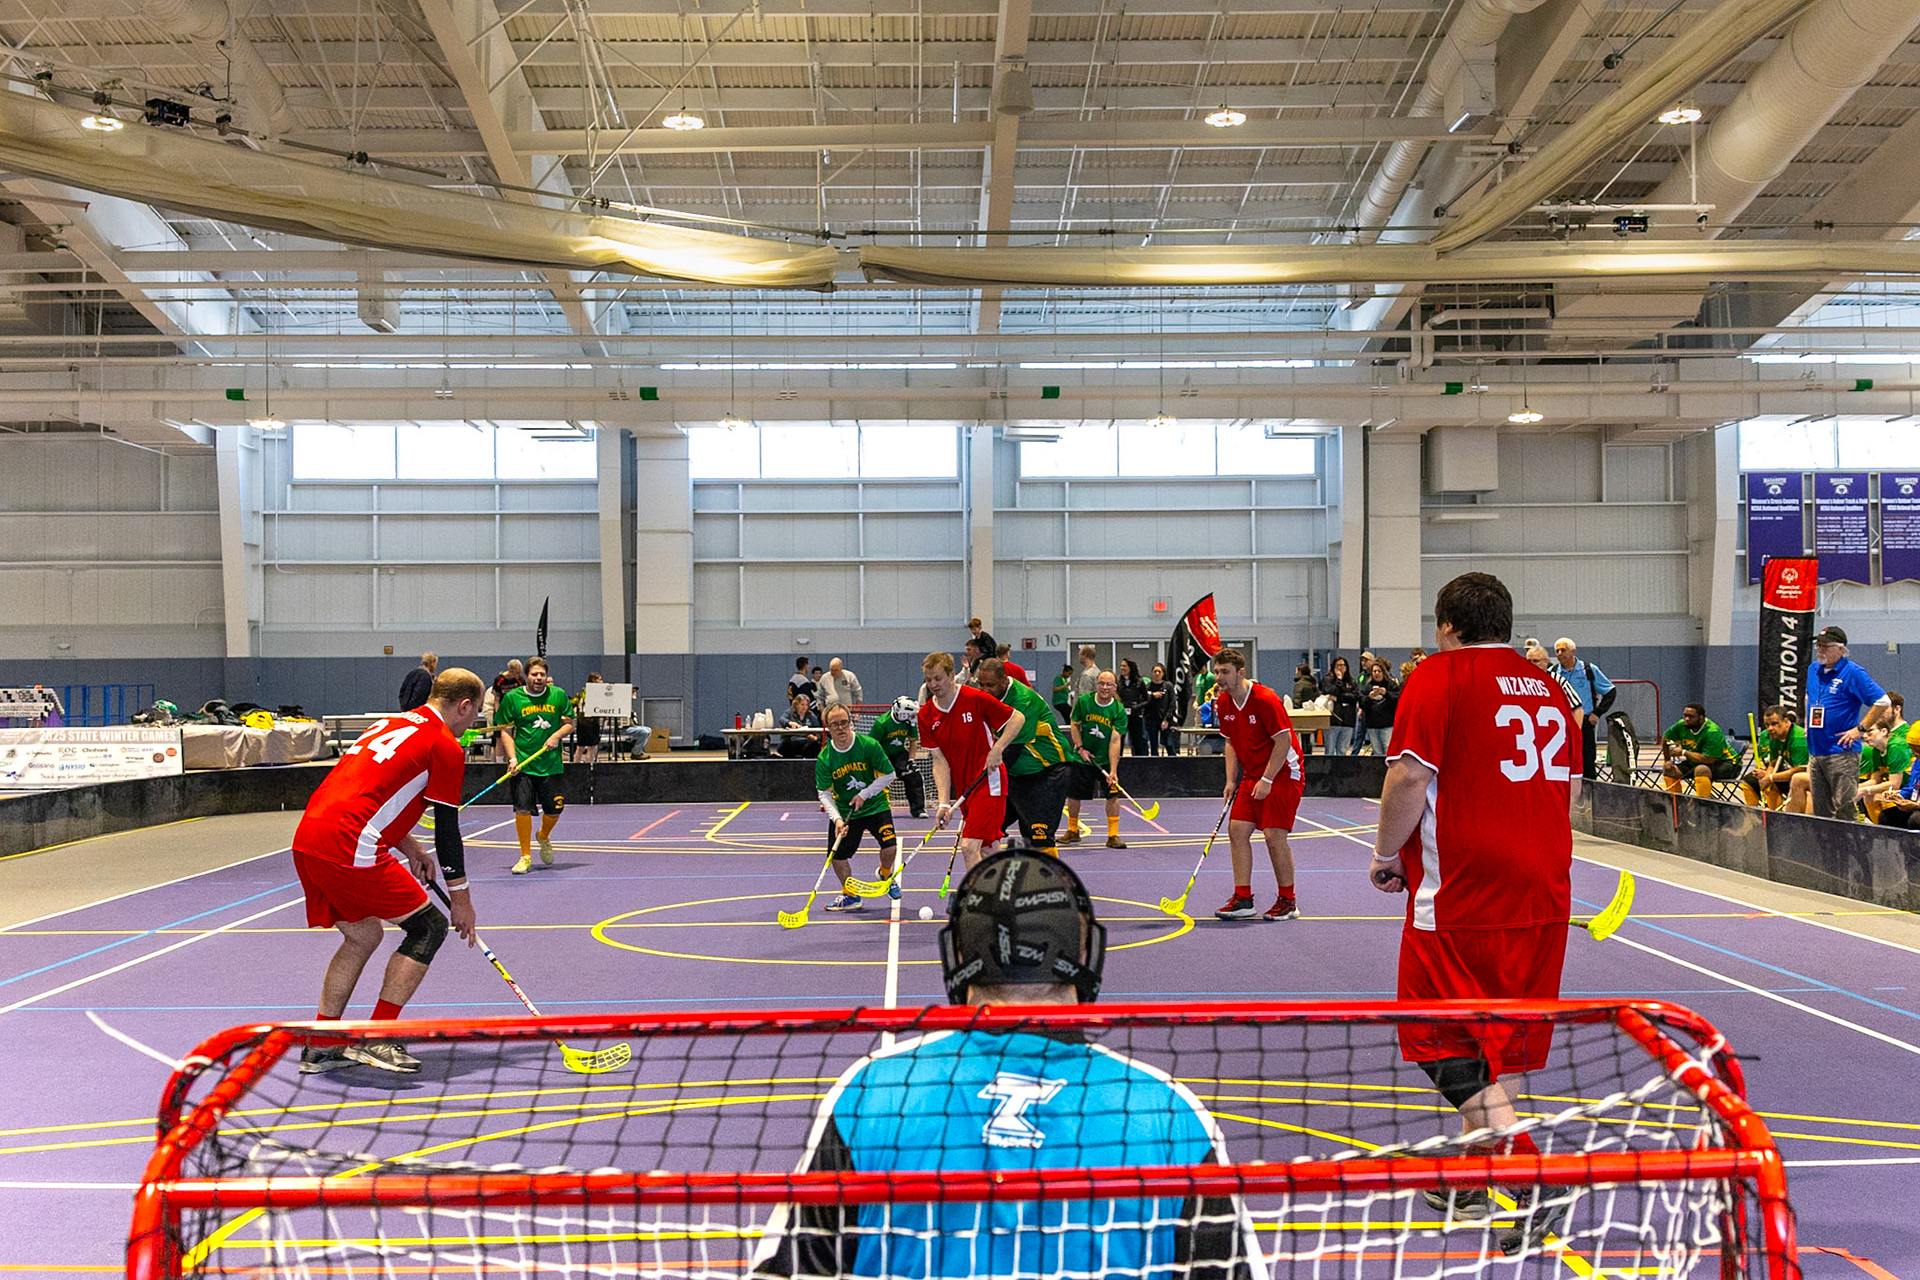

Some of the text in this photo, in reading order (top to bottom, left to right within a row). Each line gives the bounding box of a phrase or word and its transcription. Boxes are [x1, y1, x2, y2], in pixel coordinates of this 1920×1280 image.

[1781, 615, 1799, 630] 4
[1044, 634, 1060, 647] 10
[1495, 676, 1551, 698] WIZARDS
[521, 704, 556, 718] COMMACK
[593, 706, 615, 714] Court
[962, 712, 973, 723] 16
[40, 730, 176, 742] 2025 STATE WINTER GAMES
[345, 719, 419, 765] 24
[1494, 704, 1571, 783] 32
[832, 762, 867, 780] COMMACK
